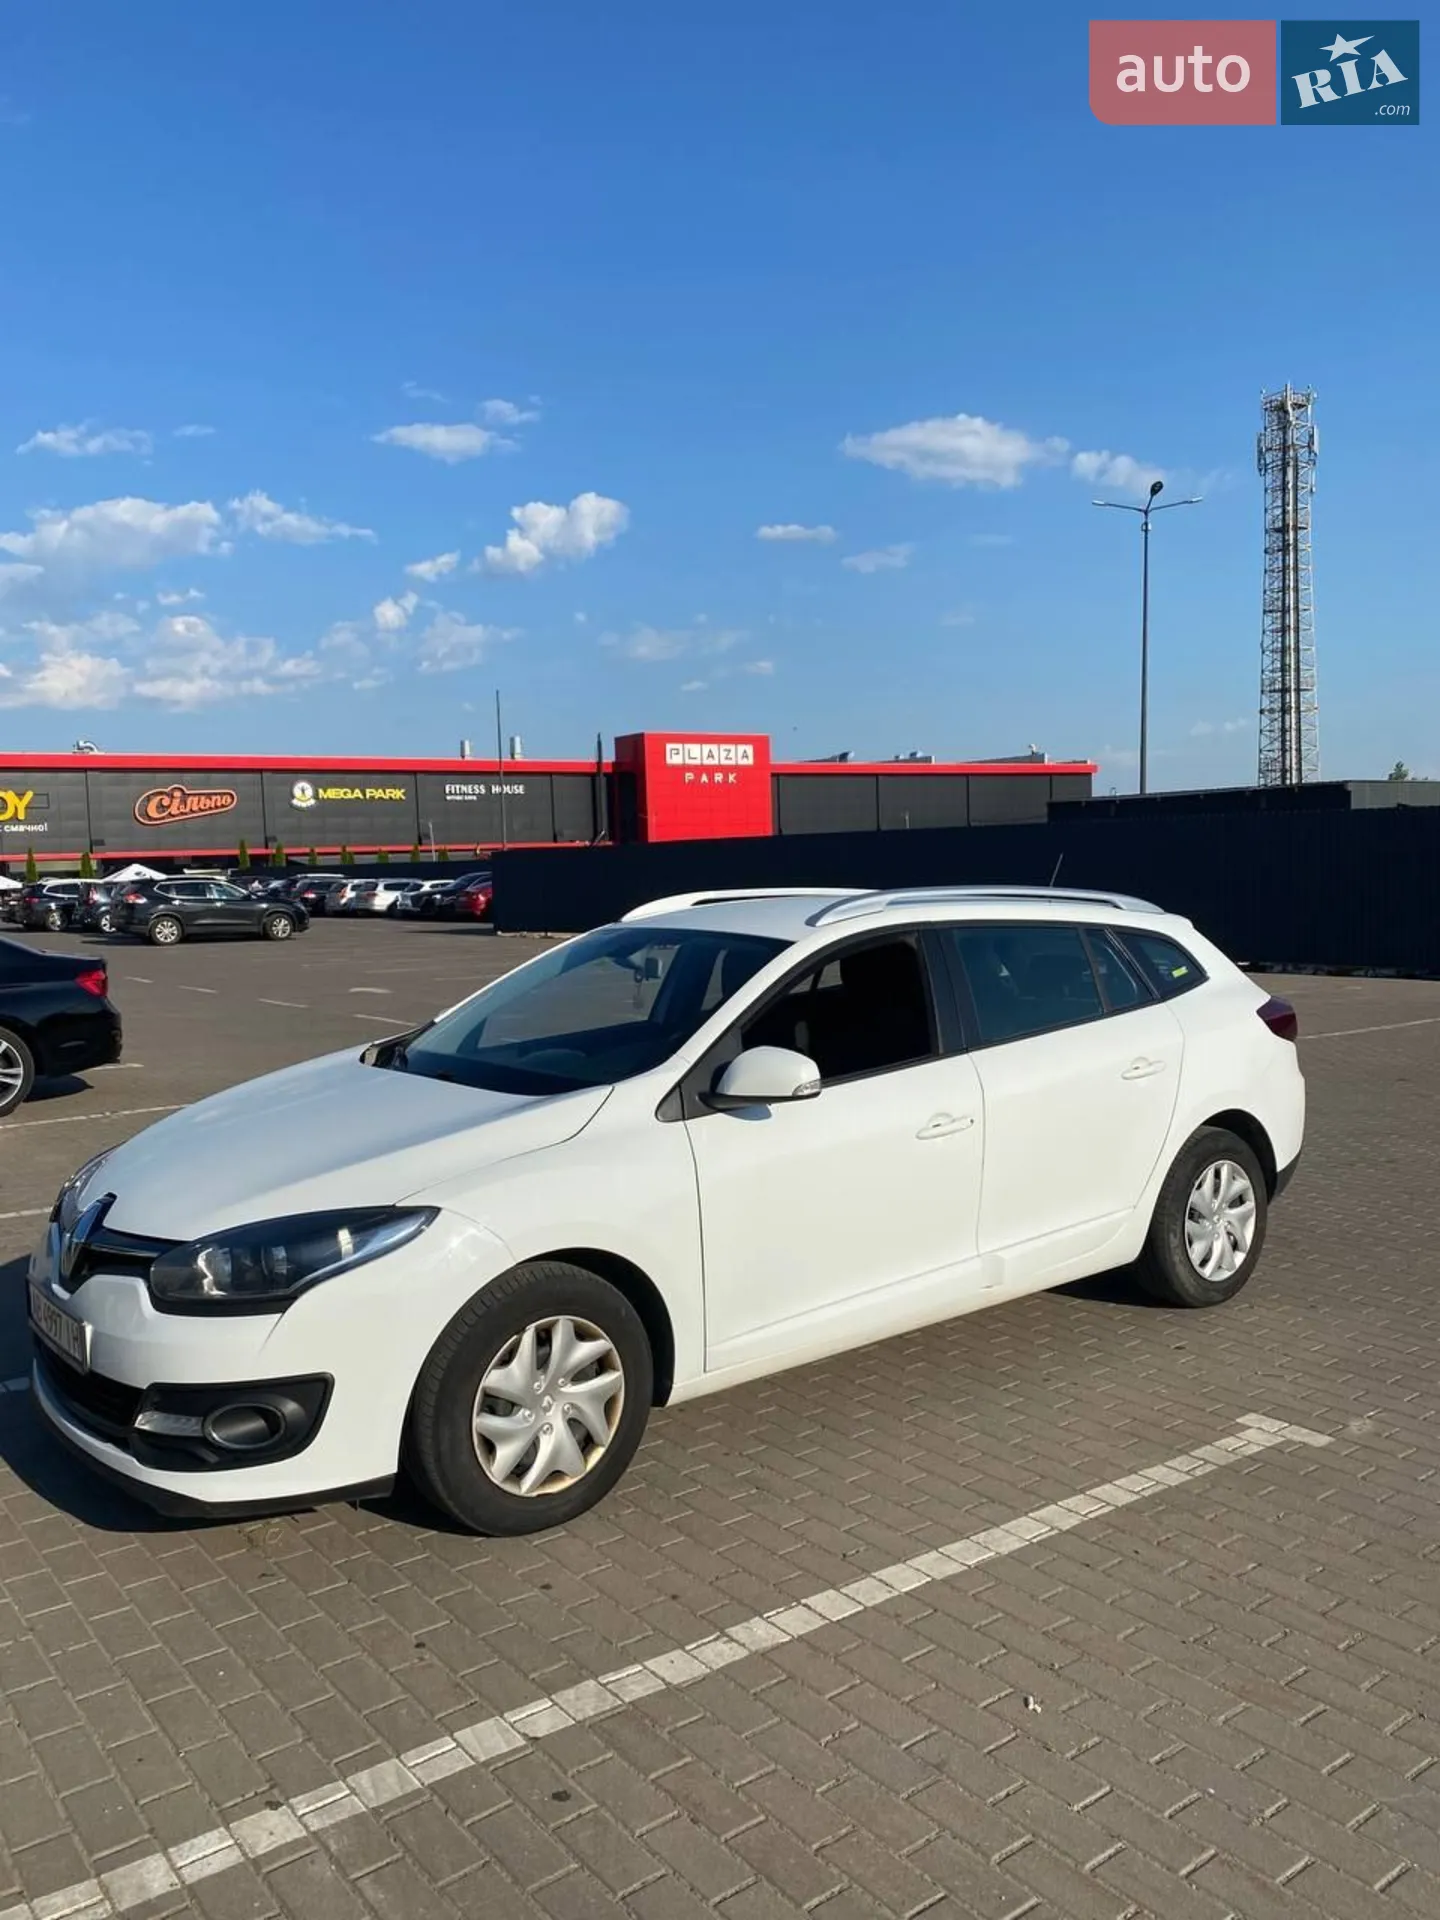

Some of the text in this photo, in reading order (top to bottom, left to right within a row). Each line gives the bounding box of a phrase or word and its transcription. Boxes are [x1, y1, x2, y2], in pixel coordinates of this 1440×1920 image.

[668, 746, 751, 762] PLAZA
[684, 772, 738, 784] PARK
[317, 788, 406, 800] MEGA PARK
[445, 784, 485, 794] FITNESS
[147, 790, 232, 818] Сільпо
